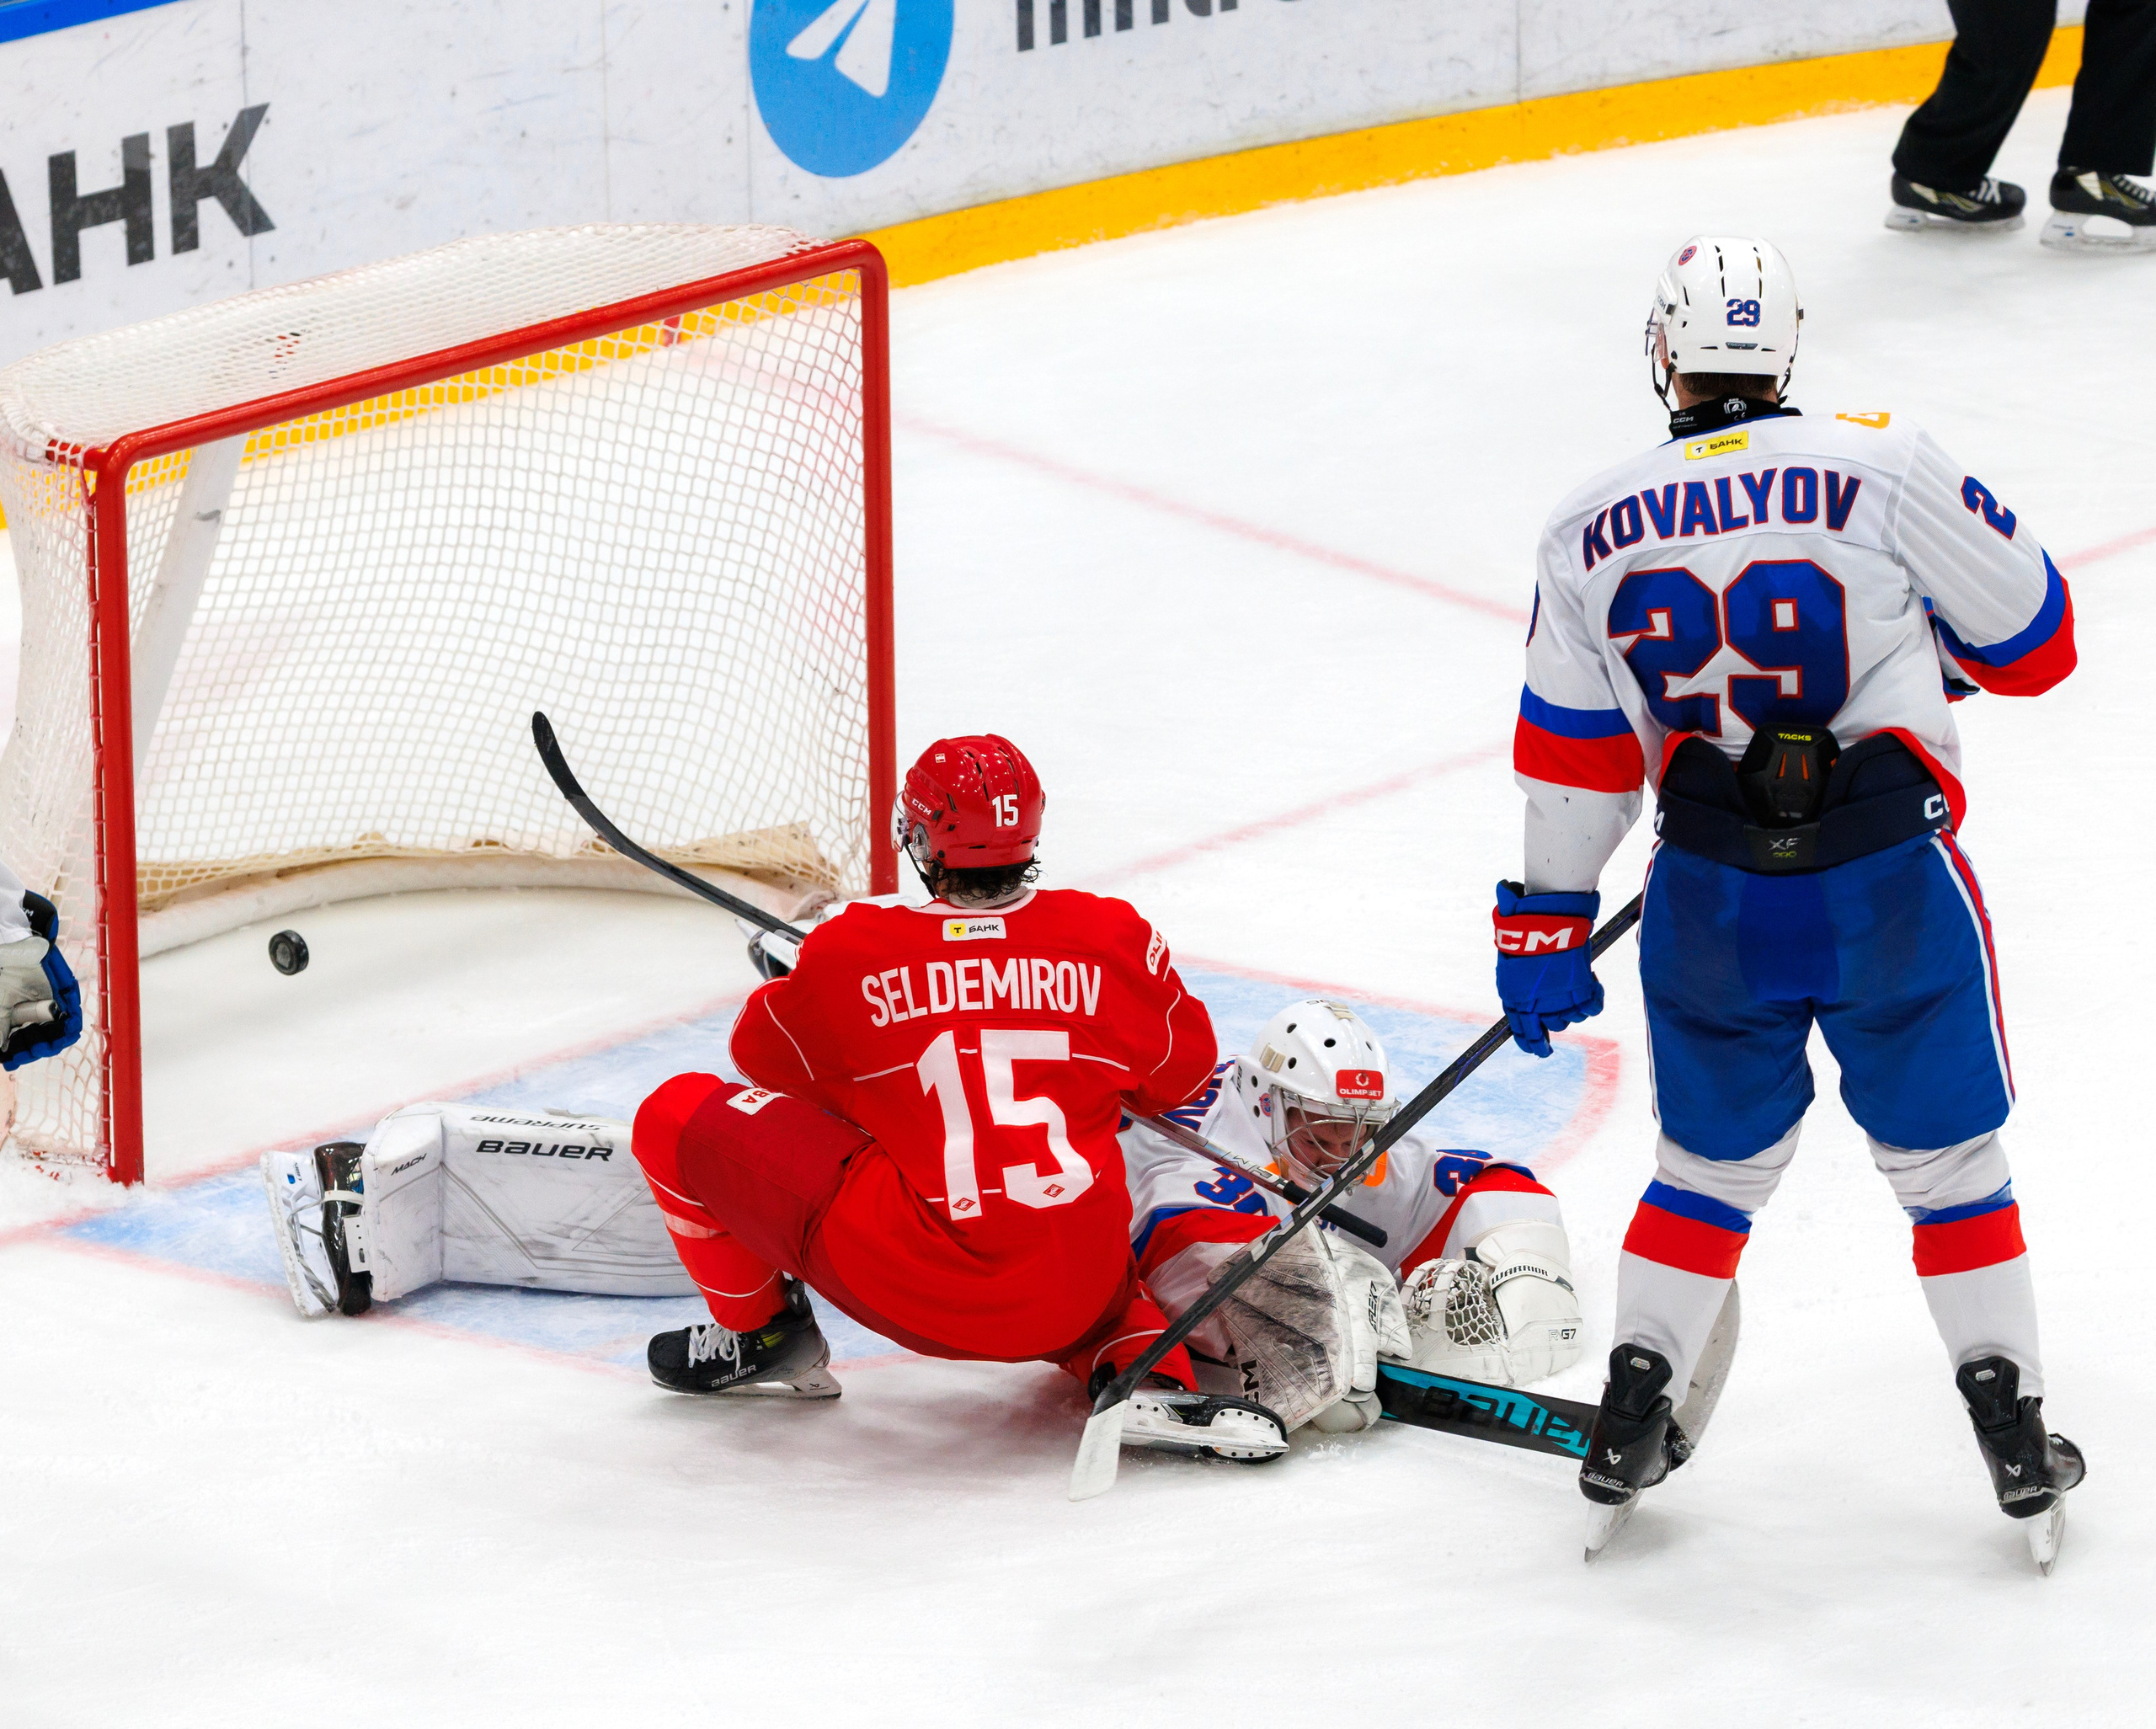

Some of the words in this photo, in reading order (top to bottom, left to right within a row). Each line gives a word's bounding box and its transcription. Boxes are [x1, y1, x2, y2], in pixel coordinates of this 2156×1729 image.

[1726, 298, 1760, 327] 29
[1710, 438, 1742, 450] БАНК
[1582, 467, 1862, 571] KOVALYOV
[1608, 558, 1851, 738] 29
[1778, 733, 1812, 741] TACKS
[911, 798, 932, 816] CCM
[992, 794, 1019, 828] 15
[969, 923, 1000, 933] БАНК
[862, 958, 1102, 1027] SELDEMIROV
[916, 1028, 1094, 1221] 15
[390, 1153, 427, 1177] MACH
[1492, 1265, 1549, 1285] WARRIOR
[711, 1363, 757, 1388] BAUER
